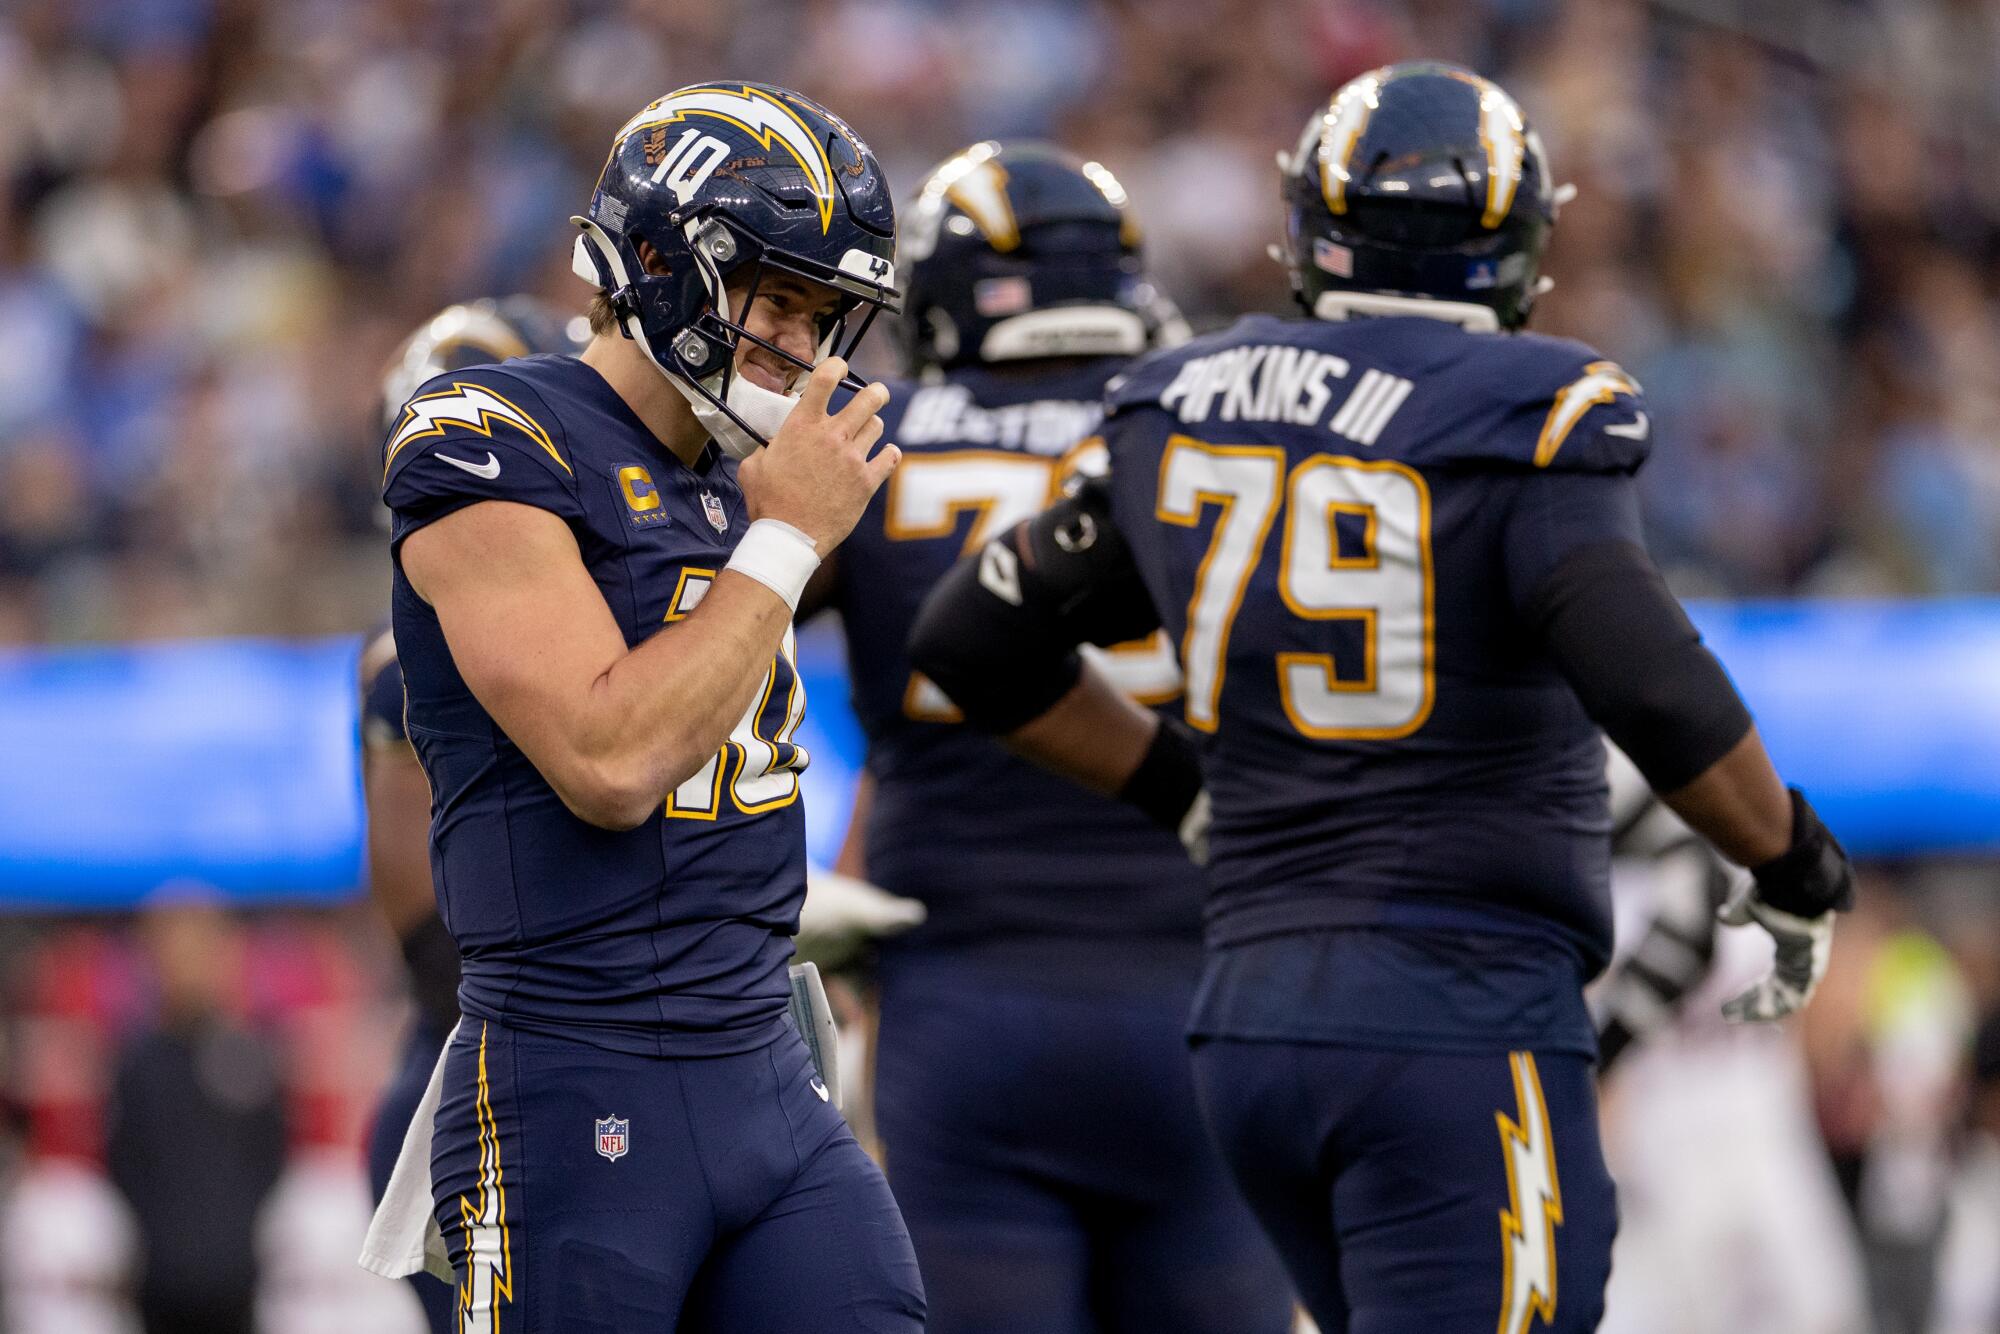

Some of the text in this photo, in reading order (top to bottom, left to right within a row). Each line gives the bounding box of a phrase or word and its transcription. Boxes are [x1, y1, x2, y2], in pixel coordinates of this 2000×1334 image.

[651, 128, 731, 196] 10
[1159, 345, 1416, 446] PIPKINS III
[619, 466, 660, 511] C
[884, 438, 1186, 724] 7
[1155, 433, 1436, 741] 79
[601, 1135, 624, 1153] NFL
